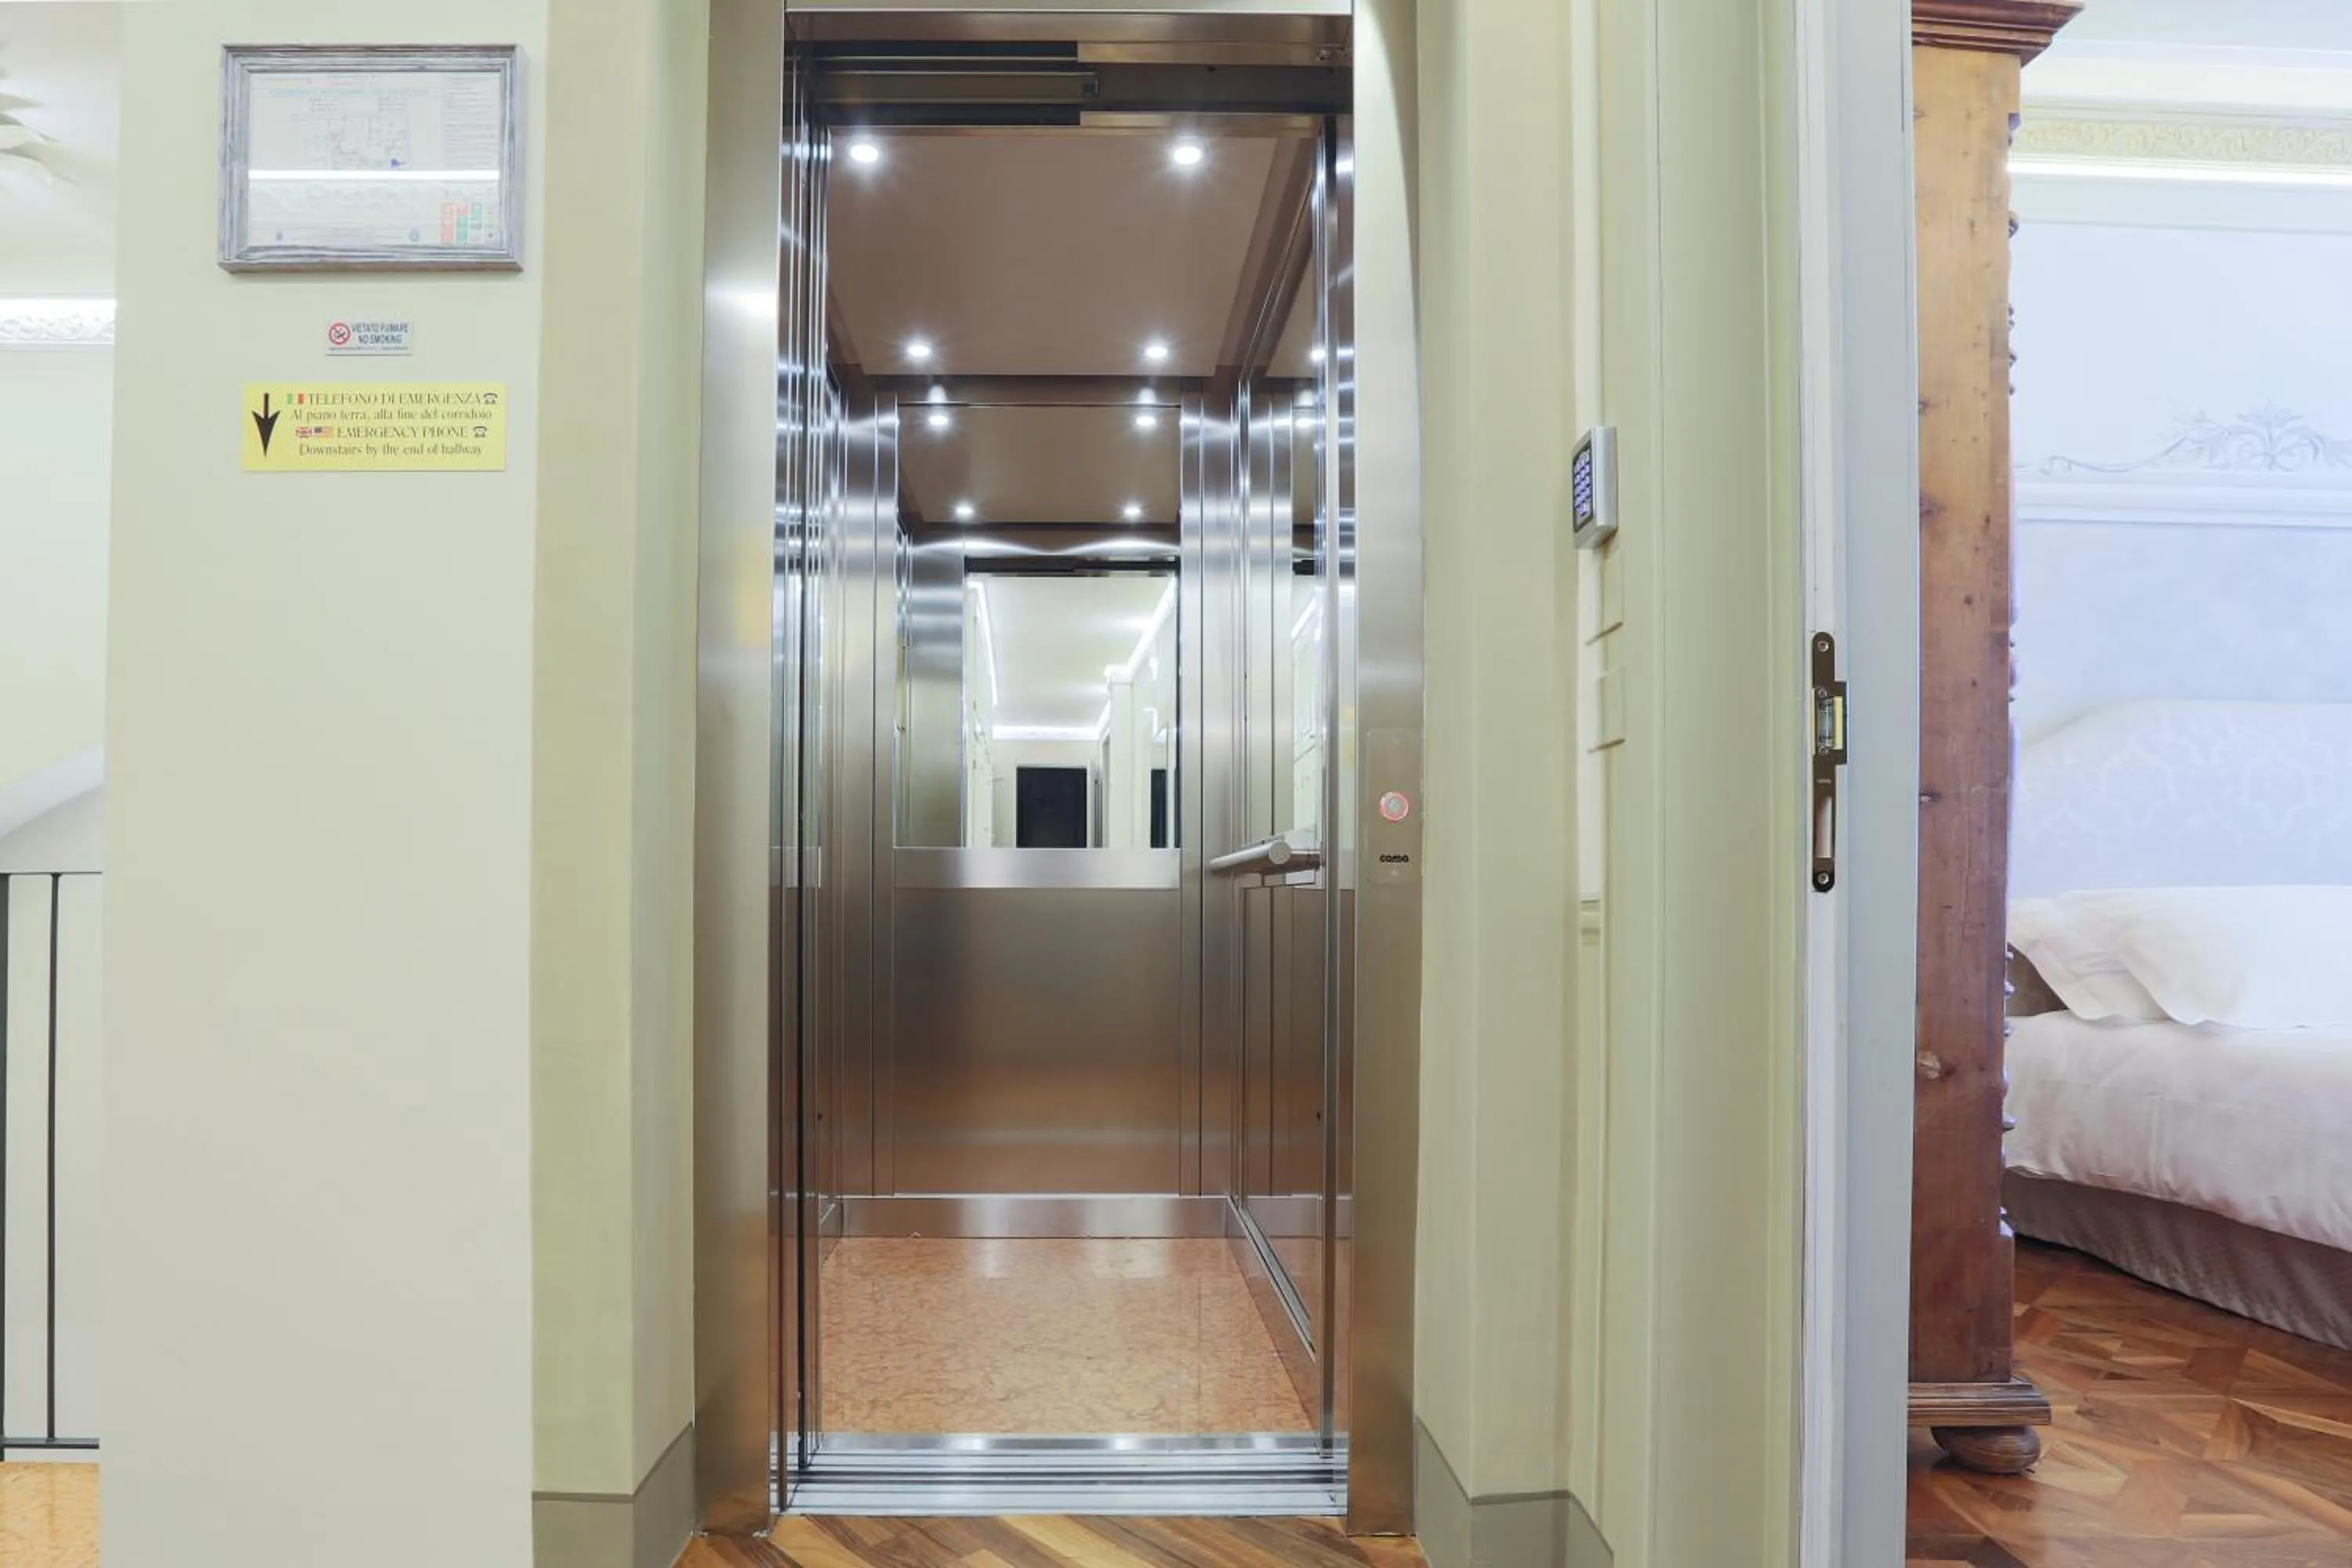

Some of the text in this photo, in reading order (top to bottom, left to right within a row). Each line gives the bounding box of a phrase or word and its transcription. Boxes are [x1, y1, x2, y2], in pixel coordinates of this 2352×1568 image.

[358, 335, 402, 344] NO SMOKING
[308, 393, 481, 405] TELEFONO DI EMERGENZA
[291, 409, 302, 420] Al
[307, 411, 337, 423] piano
[374, 408, 393, 419] alla
[397, 408, 414, 419] fine
[421, 408, 437, 419] del
[441, 408, 492, 420] corridoio
[337, 426, 468, 437] EMERGENCY PHONE
[299, 442, 483, 458] Downstairs by the end of hallway
